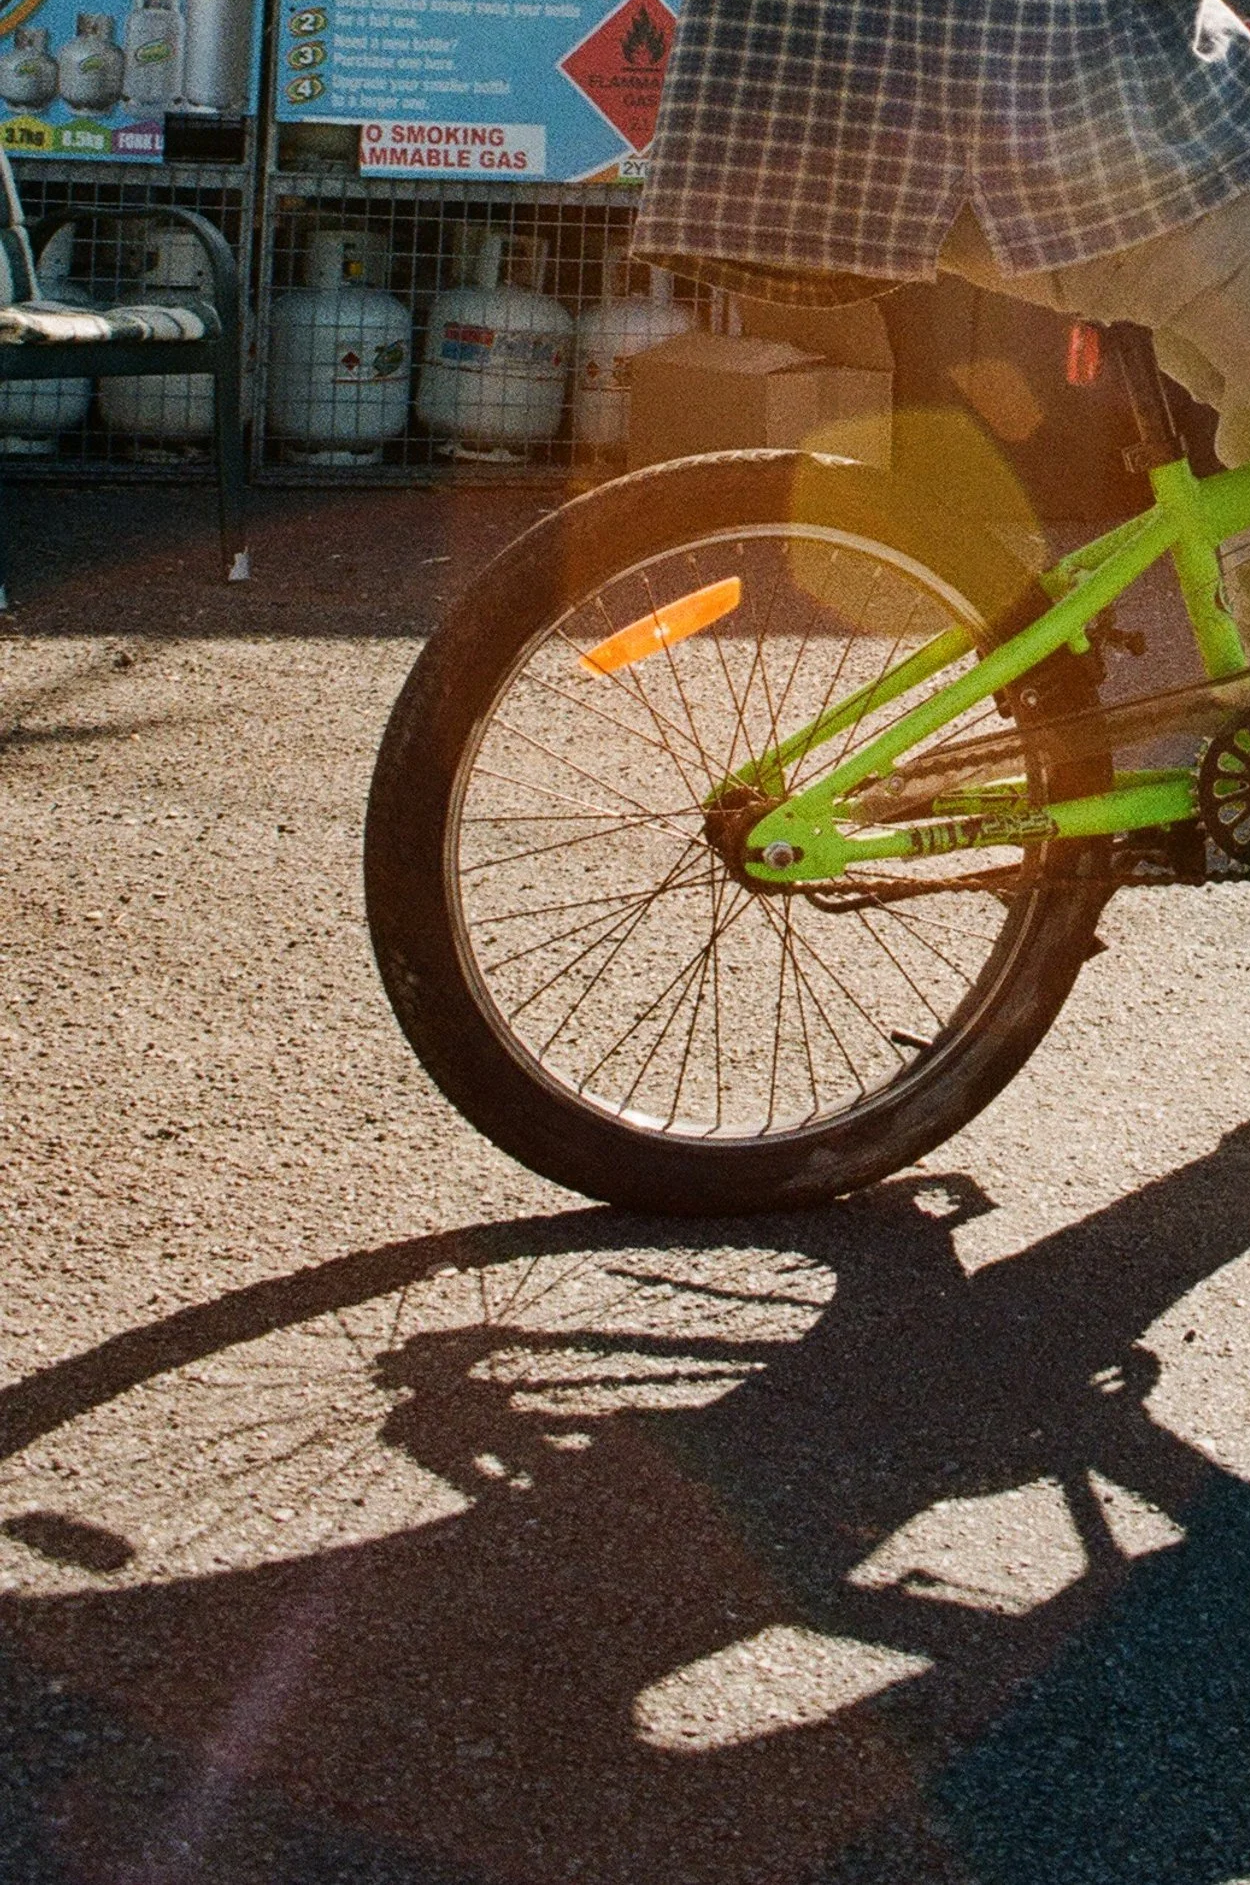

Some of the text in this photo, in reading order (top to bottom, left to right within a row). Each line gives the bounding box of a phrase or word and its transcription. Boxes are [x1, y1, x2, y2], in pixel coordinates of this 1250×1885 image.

[301, 13, 315, 31] 2
[300, 46, 313, 65] 3
[297, 79, 313, 98] 4
[392, 124, 505, 147] SMOKING
[480, 149, 528, 170] GAS
[623, 161, 651, 176] 2Y
